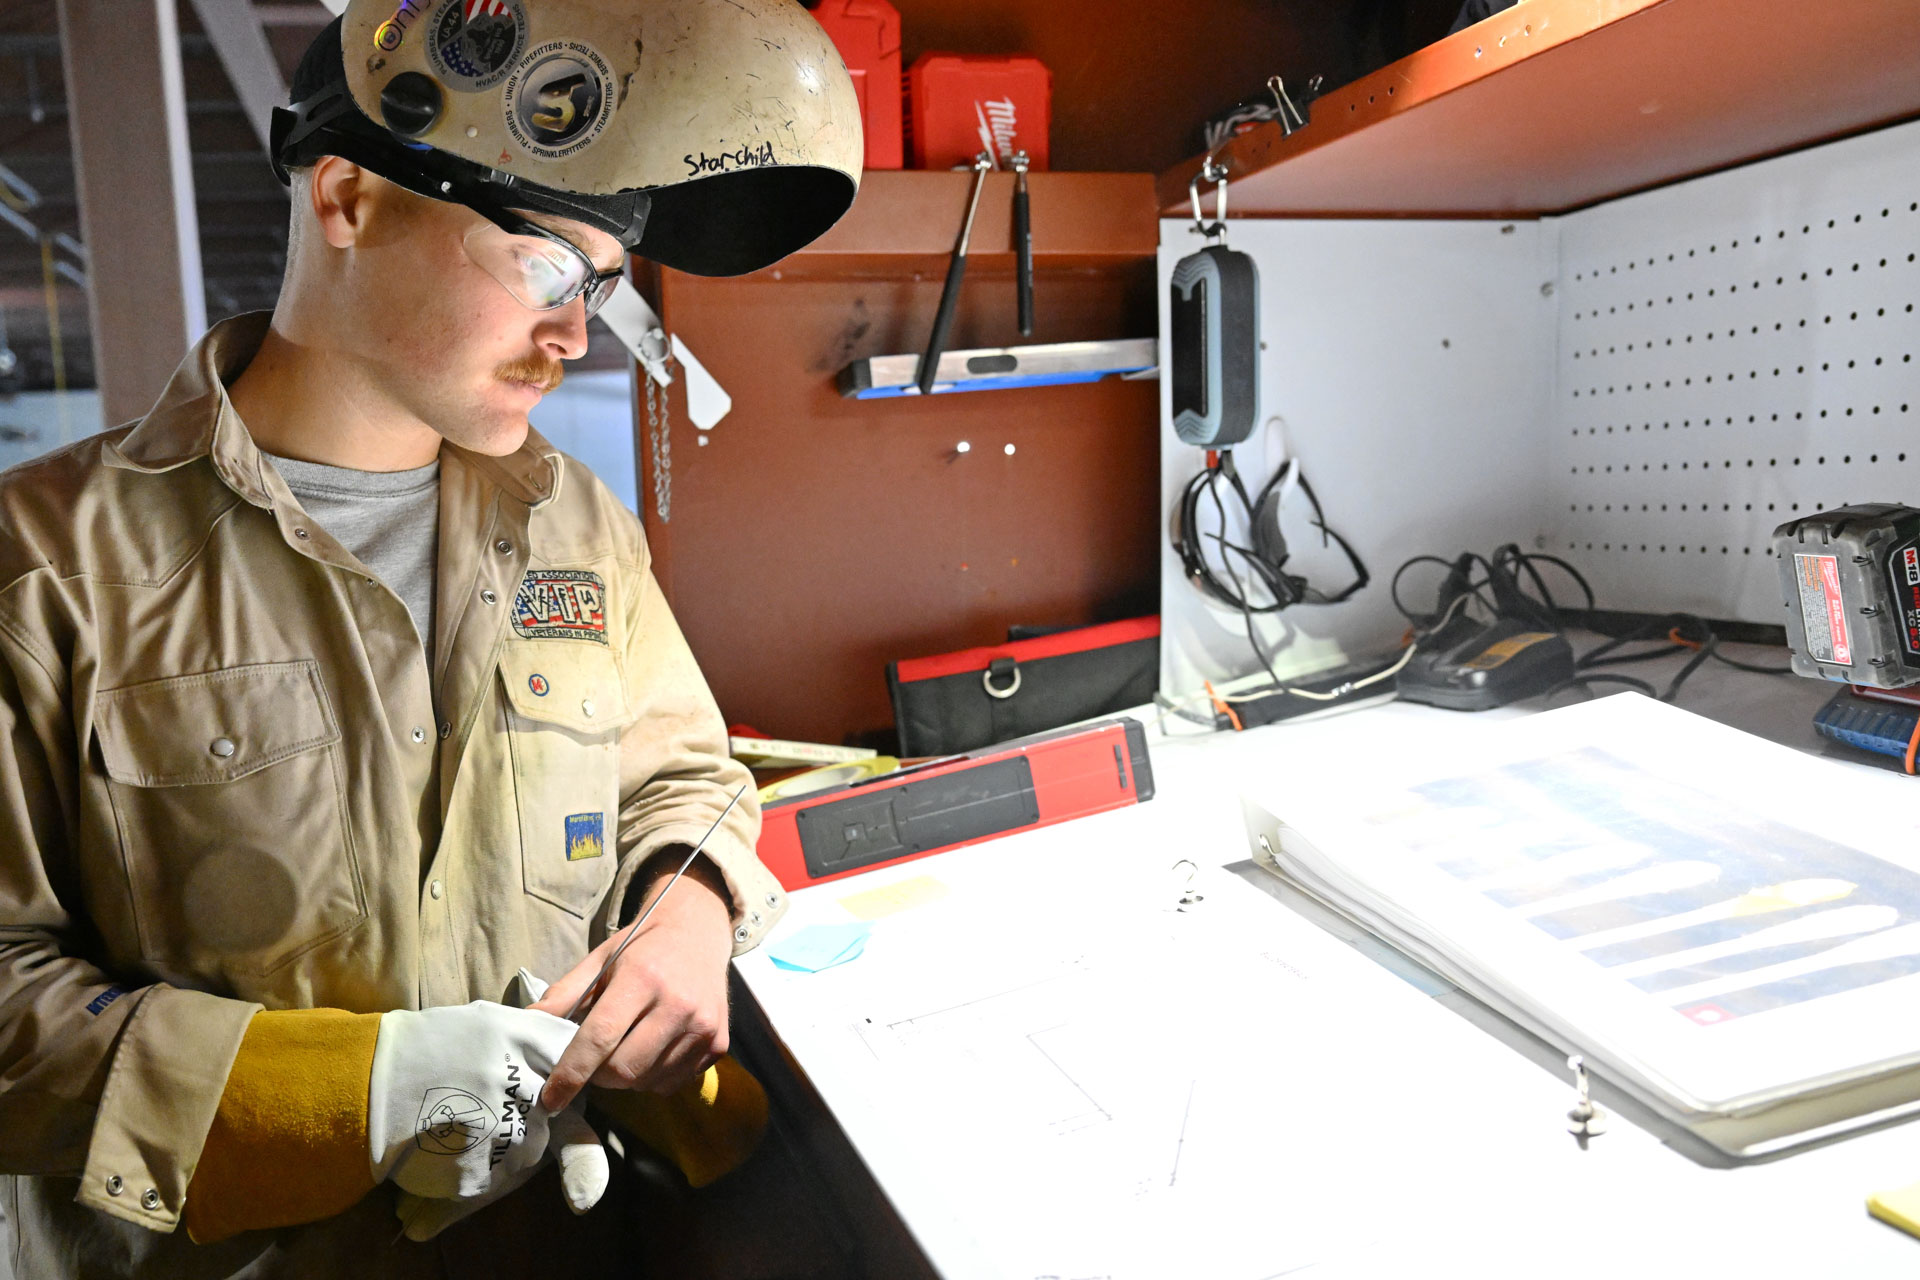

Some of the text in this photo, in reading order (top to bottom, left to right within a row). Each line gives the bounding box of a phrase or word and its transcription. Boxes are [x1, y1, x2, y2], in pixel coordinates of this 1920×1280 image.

[512, 3, 526, 33] TECHS
[505, 35, 525, 70] SERVICE
[520, 41, 563, 69] PIPEFITTERS
[569, 42, 590, 55] TECHS
[588, 51, 609, 76] SERVICE
[475, 70, 506, 88] HVAC/R
[505, 75, 518, 101] UNION
[594, 82, 613, 134] STEAMFITTERS
[505, 110, 529, 148] PLUMBERS
[532, 137, 592, 158] SPRINKLERFITTERS
[1905, 549, 1919, 583] M18
[519, 583, 601, 625] VIP
[530, 628, 573, 637] VETERANS
[489, 1064, 522, 1171] TILLMAN
